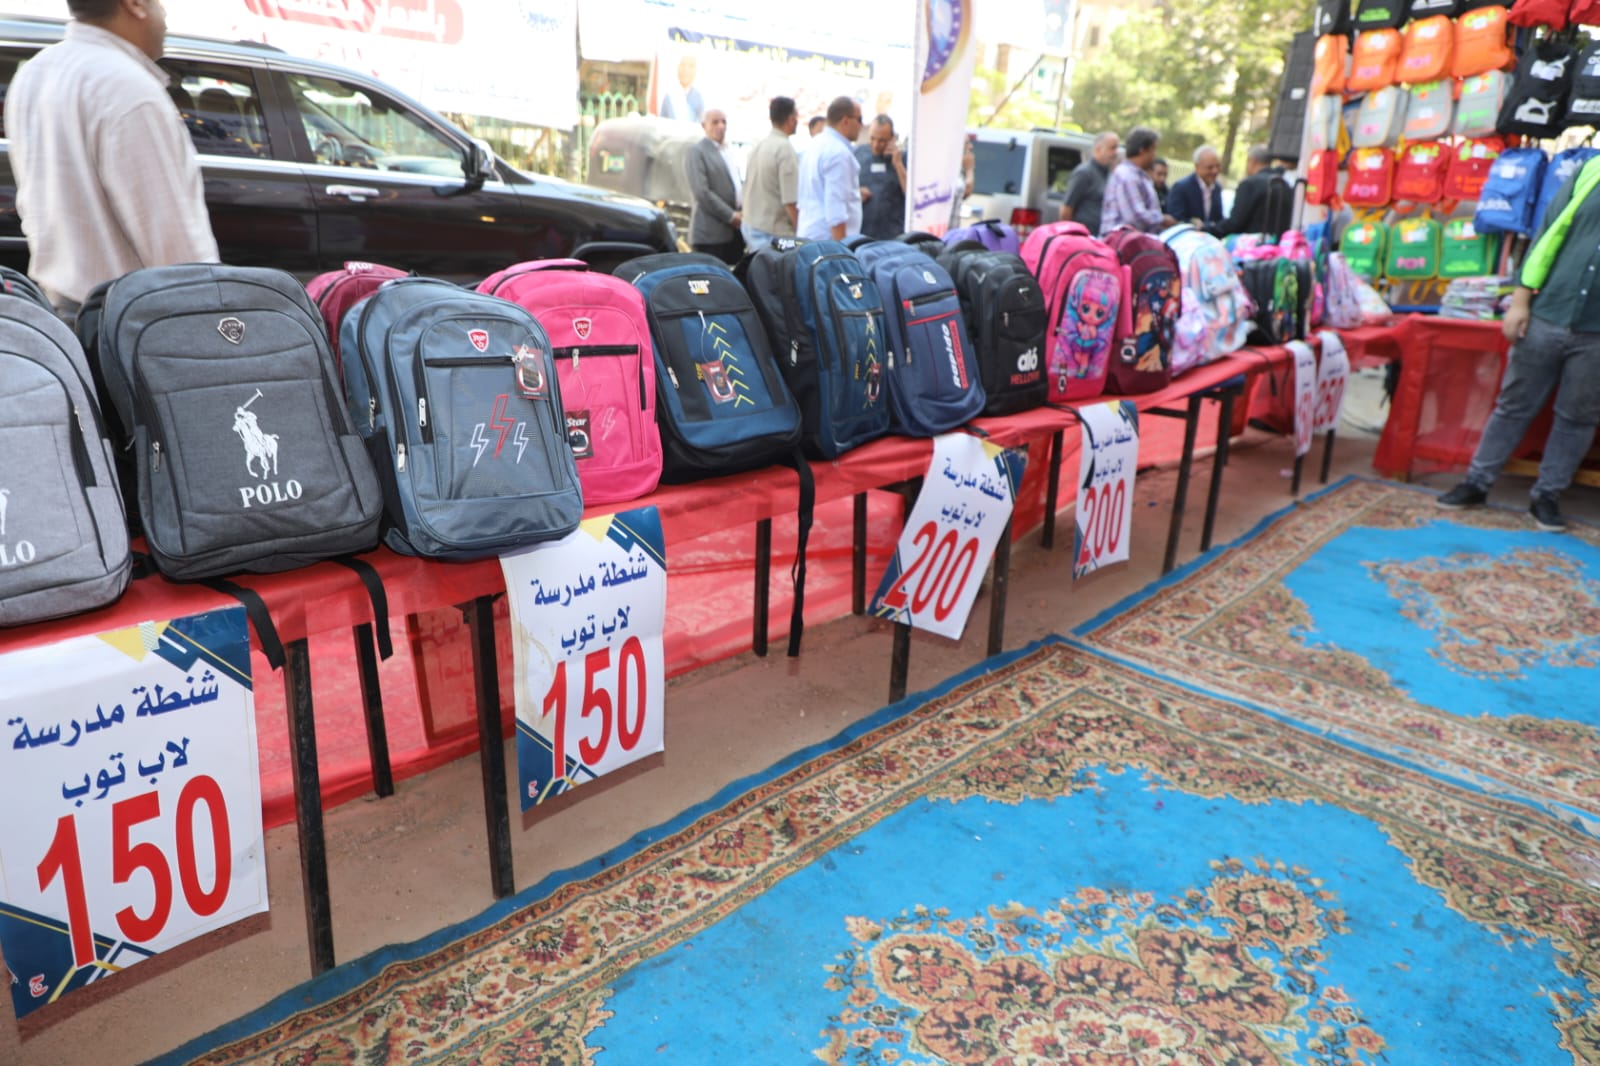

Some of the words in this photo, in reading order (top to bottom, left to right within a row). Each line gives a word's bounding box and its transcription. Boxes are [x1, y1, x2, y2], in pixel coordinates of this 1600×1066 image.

[566, 417, 587, 427] Star
[943, 457, 978, 488] مدرسة
[979, 472, 1007, 501] شنطة
[238, 479, 303, 508] POLO
[941, 503, 968, 524] توب
[963, 510, 986, 530] لاب
[1078, 478, 1126, 567] 200
[599, 552, 648, 588] شنطة
[883, 520, 979, 622] 200
[530, 573, 596, 607] مدرسة
[561, 614, 596, 656] توب
[602, 605, 631, 642] لاب
[132, 669, 219, 717] شنطة
[542, 635, 647, 780] 150
[7, 703, 125, 750] مدرسة
[62, 752, 126, 808] توب
[138, 737, 191, 785] لاب
[36, 774, 232, 969] 150
